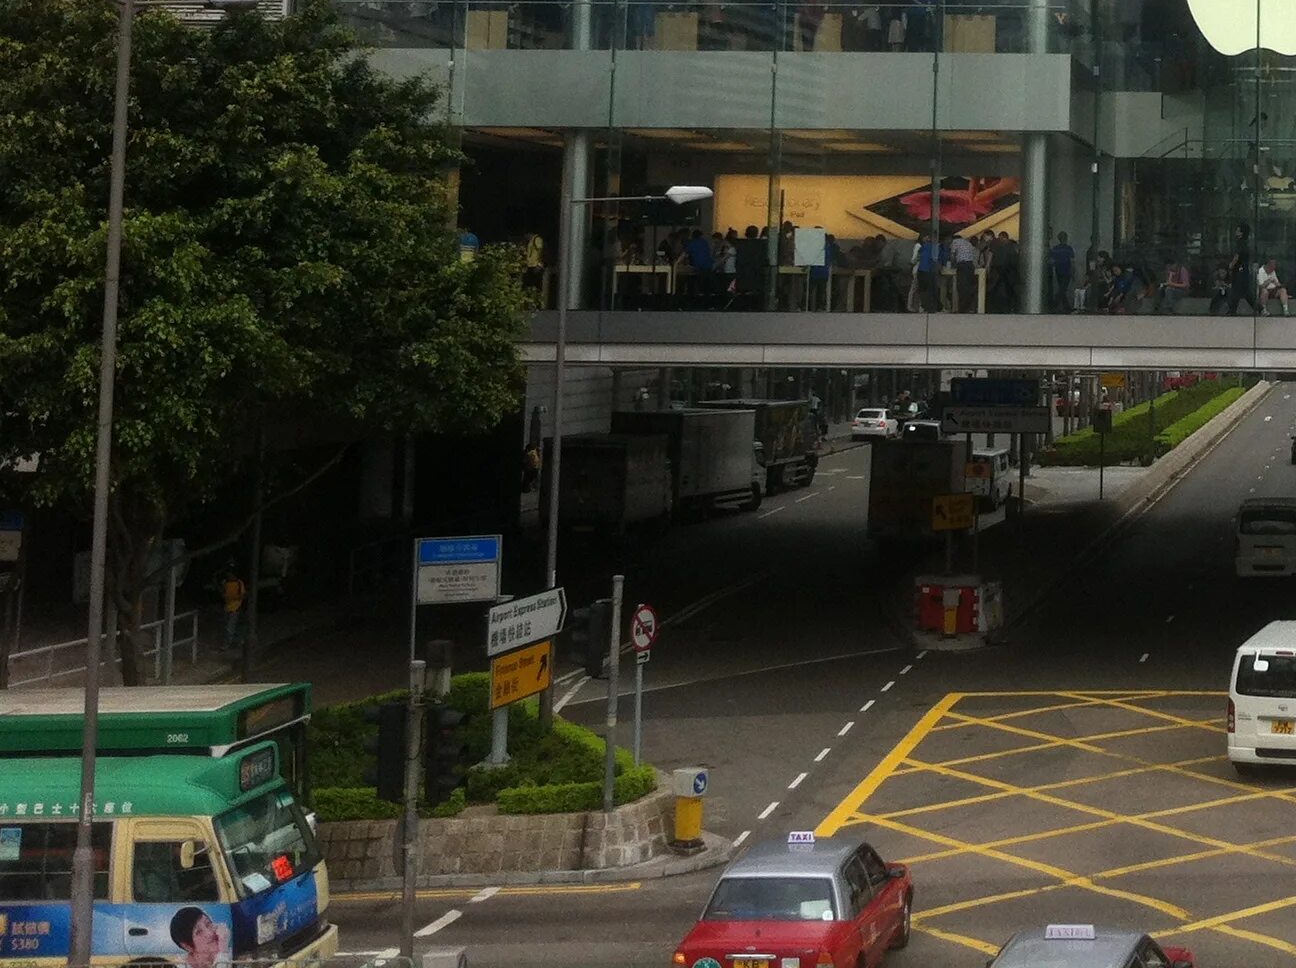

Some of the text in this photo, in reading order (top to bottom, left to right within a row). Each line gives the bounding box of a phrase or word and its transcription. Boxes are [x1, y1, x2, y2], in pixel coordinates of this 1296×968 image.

[491, 596, 558, 624] Airport Express Station
[791, 833, 811, 841] TAXI
